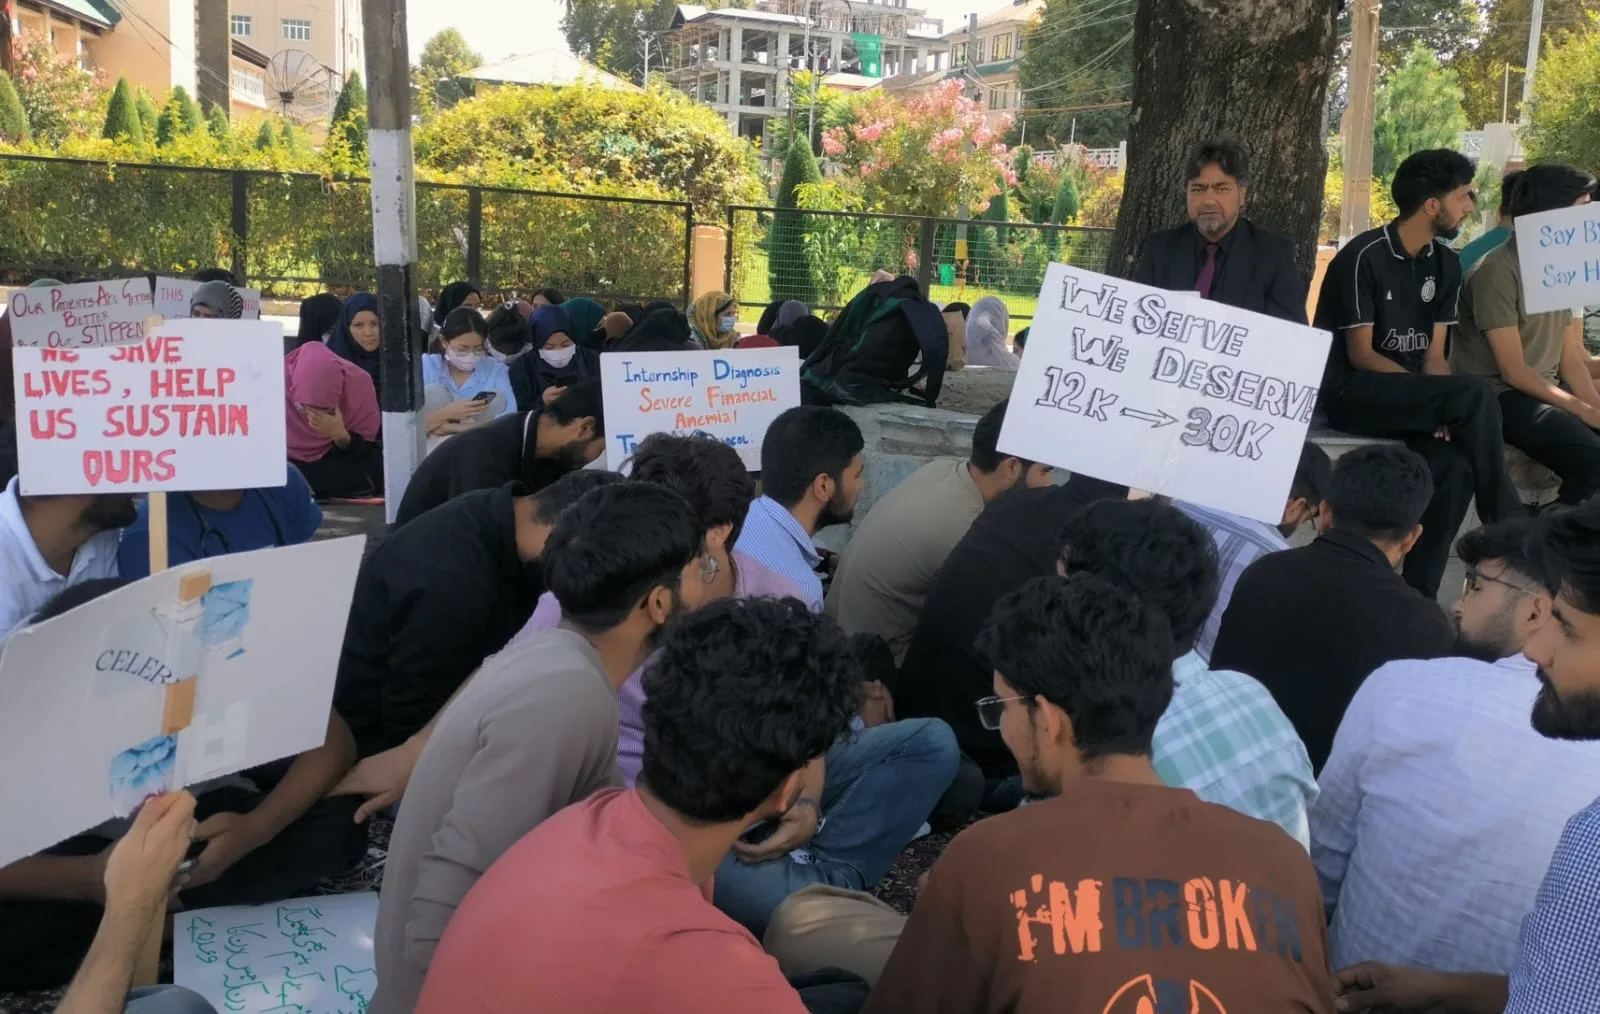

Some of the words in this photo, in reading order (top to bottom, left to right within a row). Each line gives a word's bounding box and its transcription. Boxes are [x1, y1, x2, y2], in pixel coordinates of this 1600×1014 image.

[1540, 225, 1575, 247] Say
[1542, 264, 1576, 287] Say
[1061, 275, 1127, 324] WE
[1072, 327, 1128, 372] WE
[151, 367, 236, 398] HELP
[622, 361, 698, 387] Internship
[713, 359, 781, 388] Diagnosis
[639, 388, 692, 413] Severe
[30, 408, 77, 440] US
[103, 404, 249, 437] SUSTAIN
[1179, 407, 1274, 461] 30K
[83, 449, 176, 487] OURS
[95, 649, 180, 684] CELER
